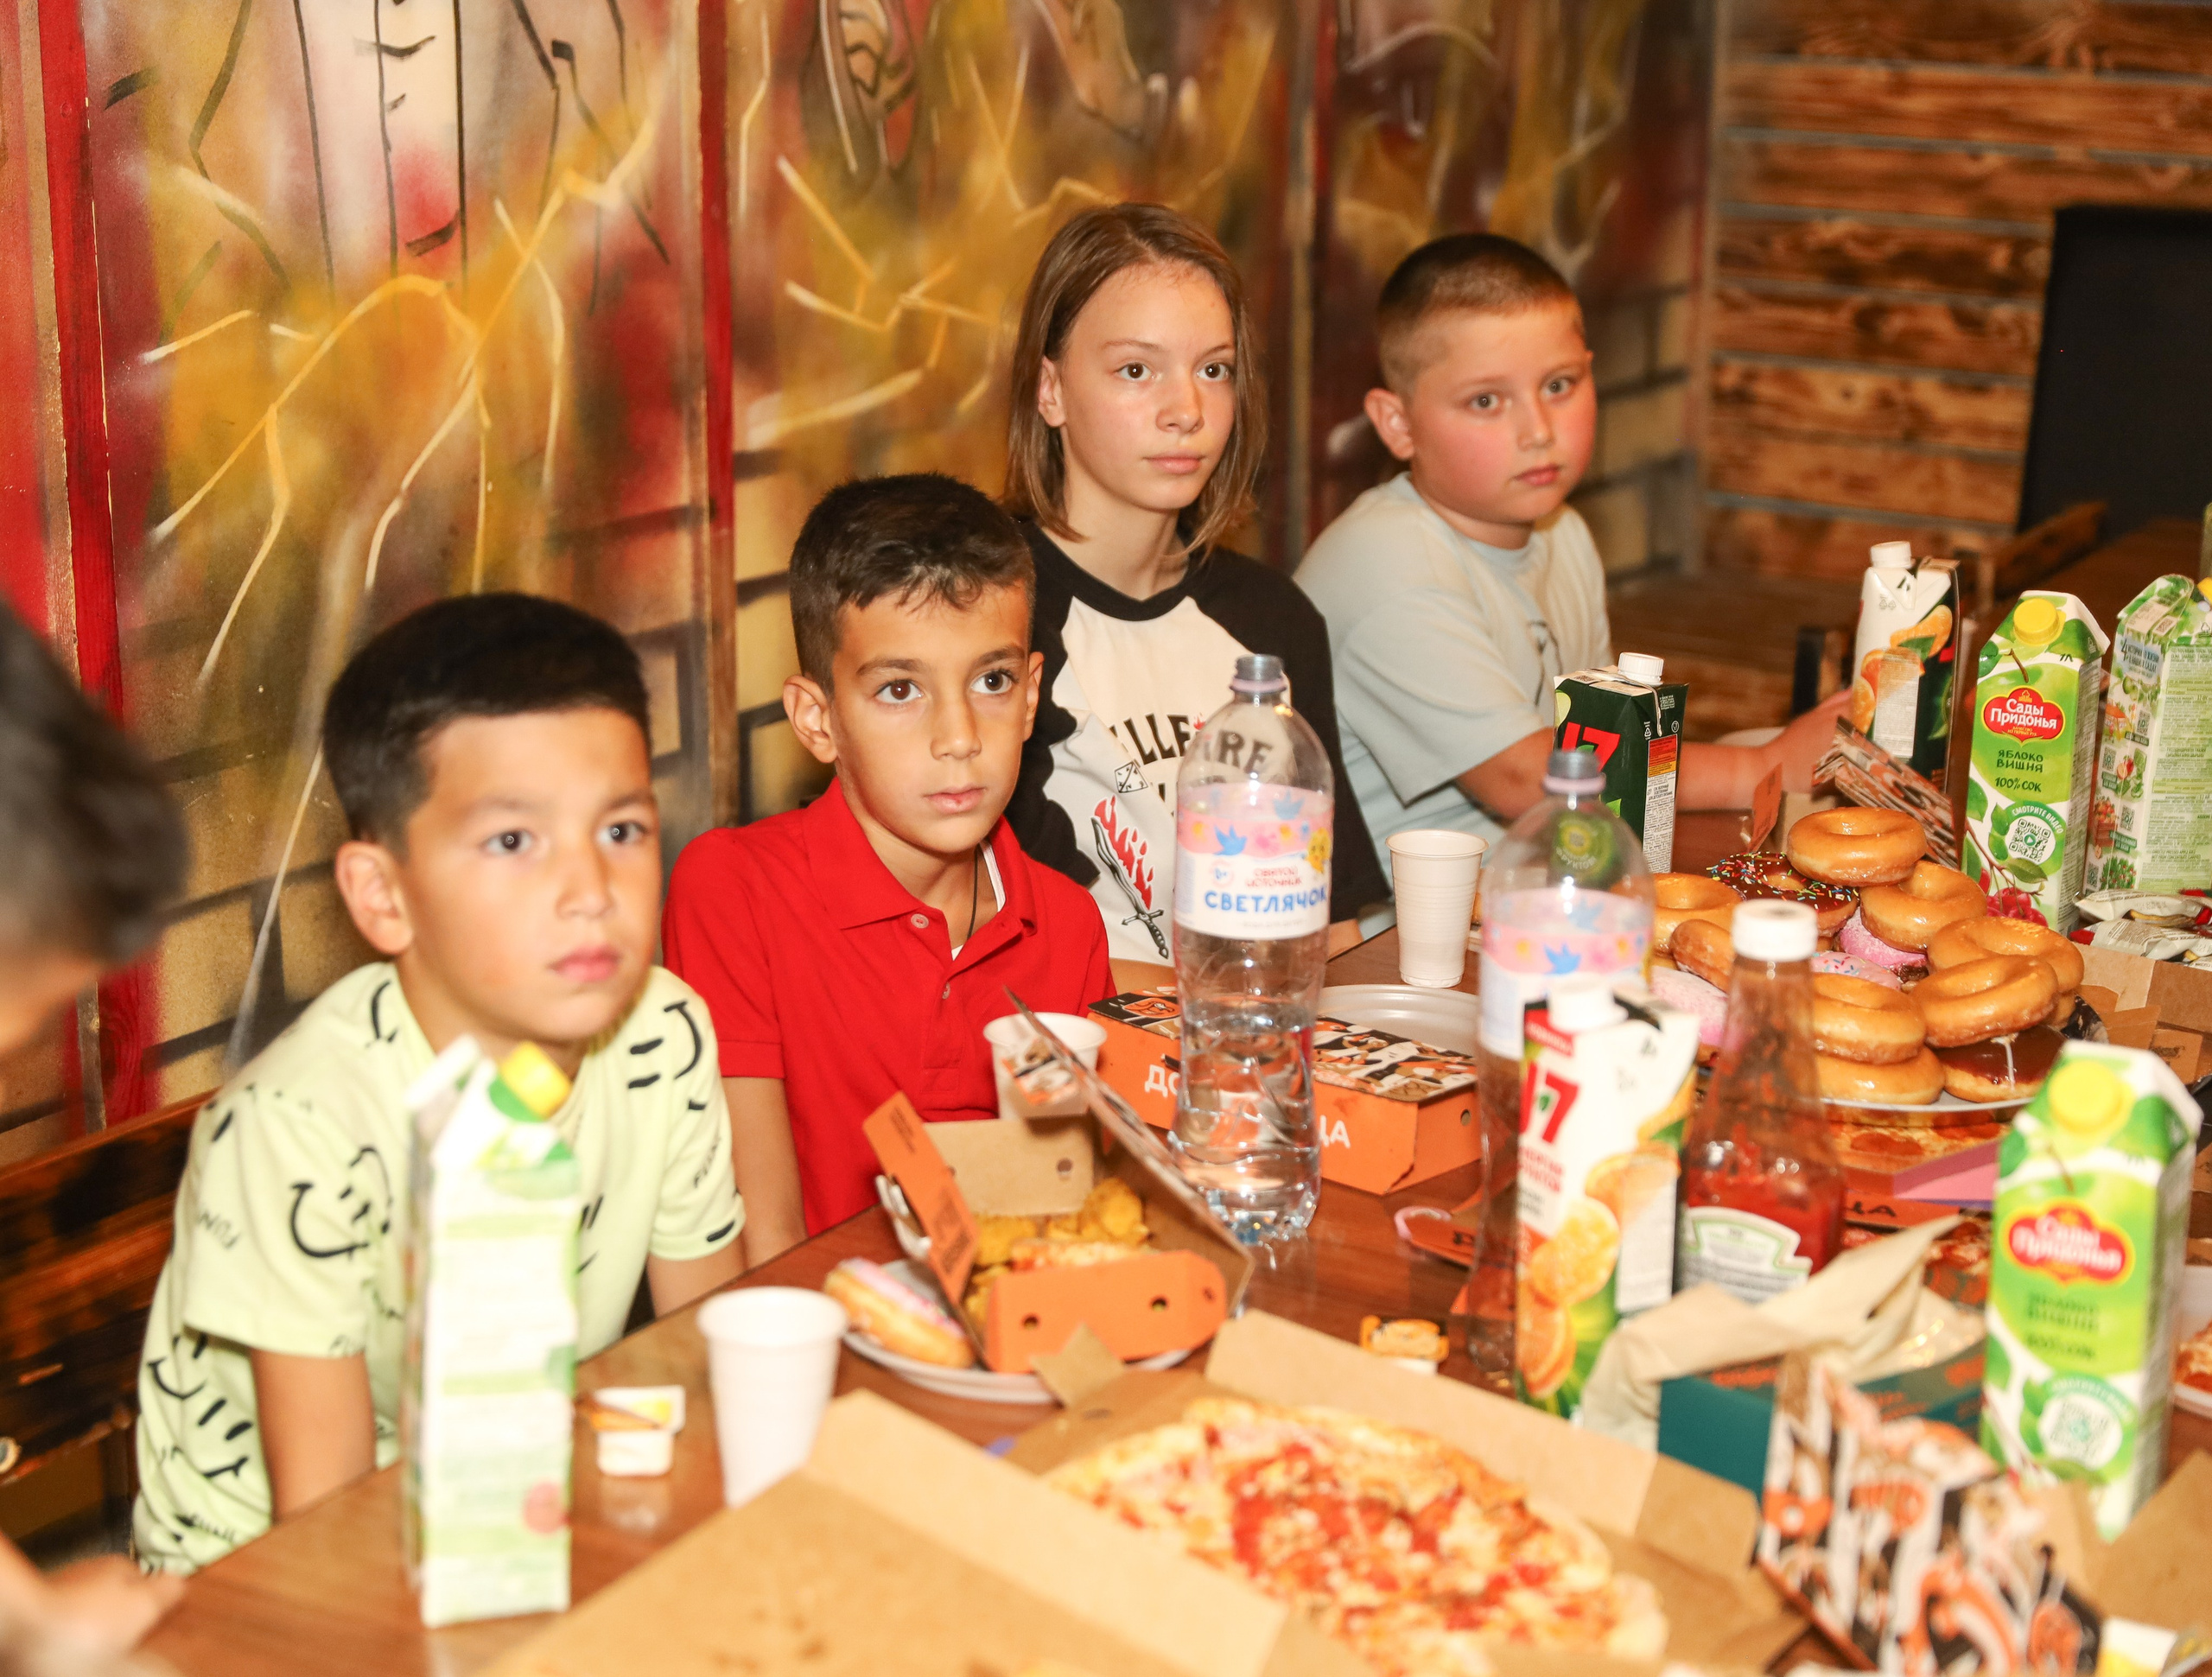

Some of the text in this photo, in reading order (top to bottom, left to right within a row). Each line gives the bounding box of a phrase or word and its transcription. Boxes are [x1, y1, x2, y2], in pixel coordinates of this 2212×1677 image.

[2006, 698, 2044, 716] Сады
[1990, 708, 2057, 729] Придонья
[1998, 749, 2044, 762] ЯБЛОКО
[1996, 759, 2044, 773] ВИШНЯ
[1995, 777, 2042, 792] 100% СОК
[2012, 805, 2064, 835] СМОТРИТЕ ВИДЕО
[1205, 885, 1326, 912] СВЕТЛЯЧОК
